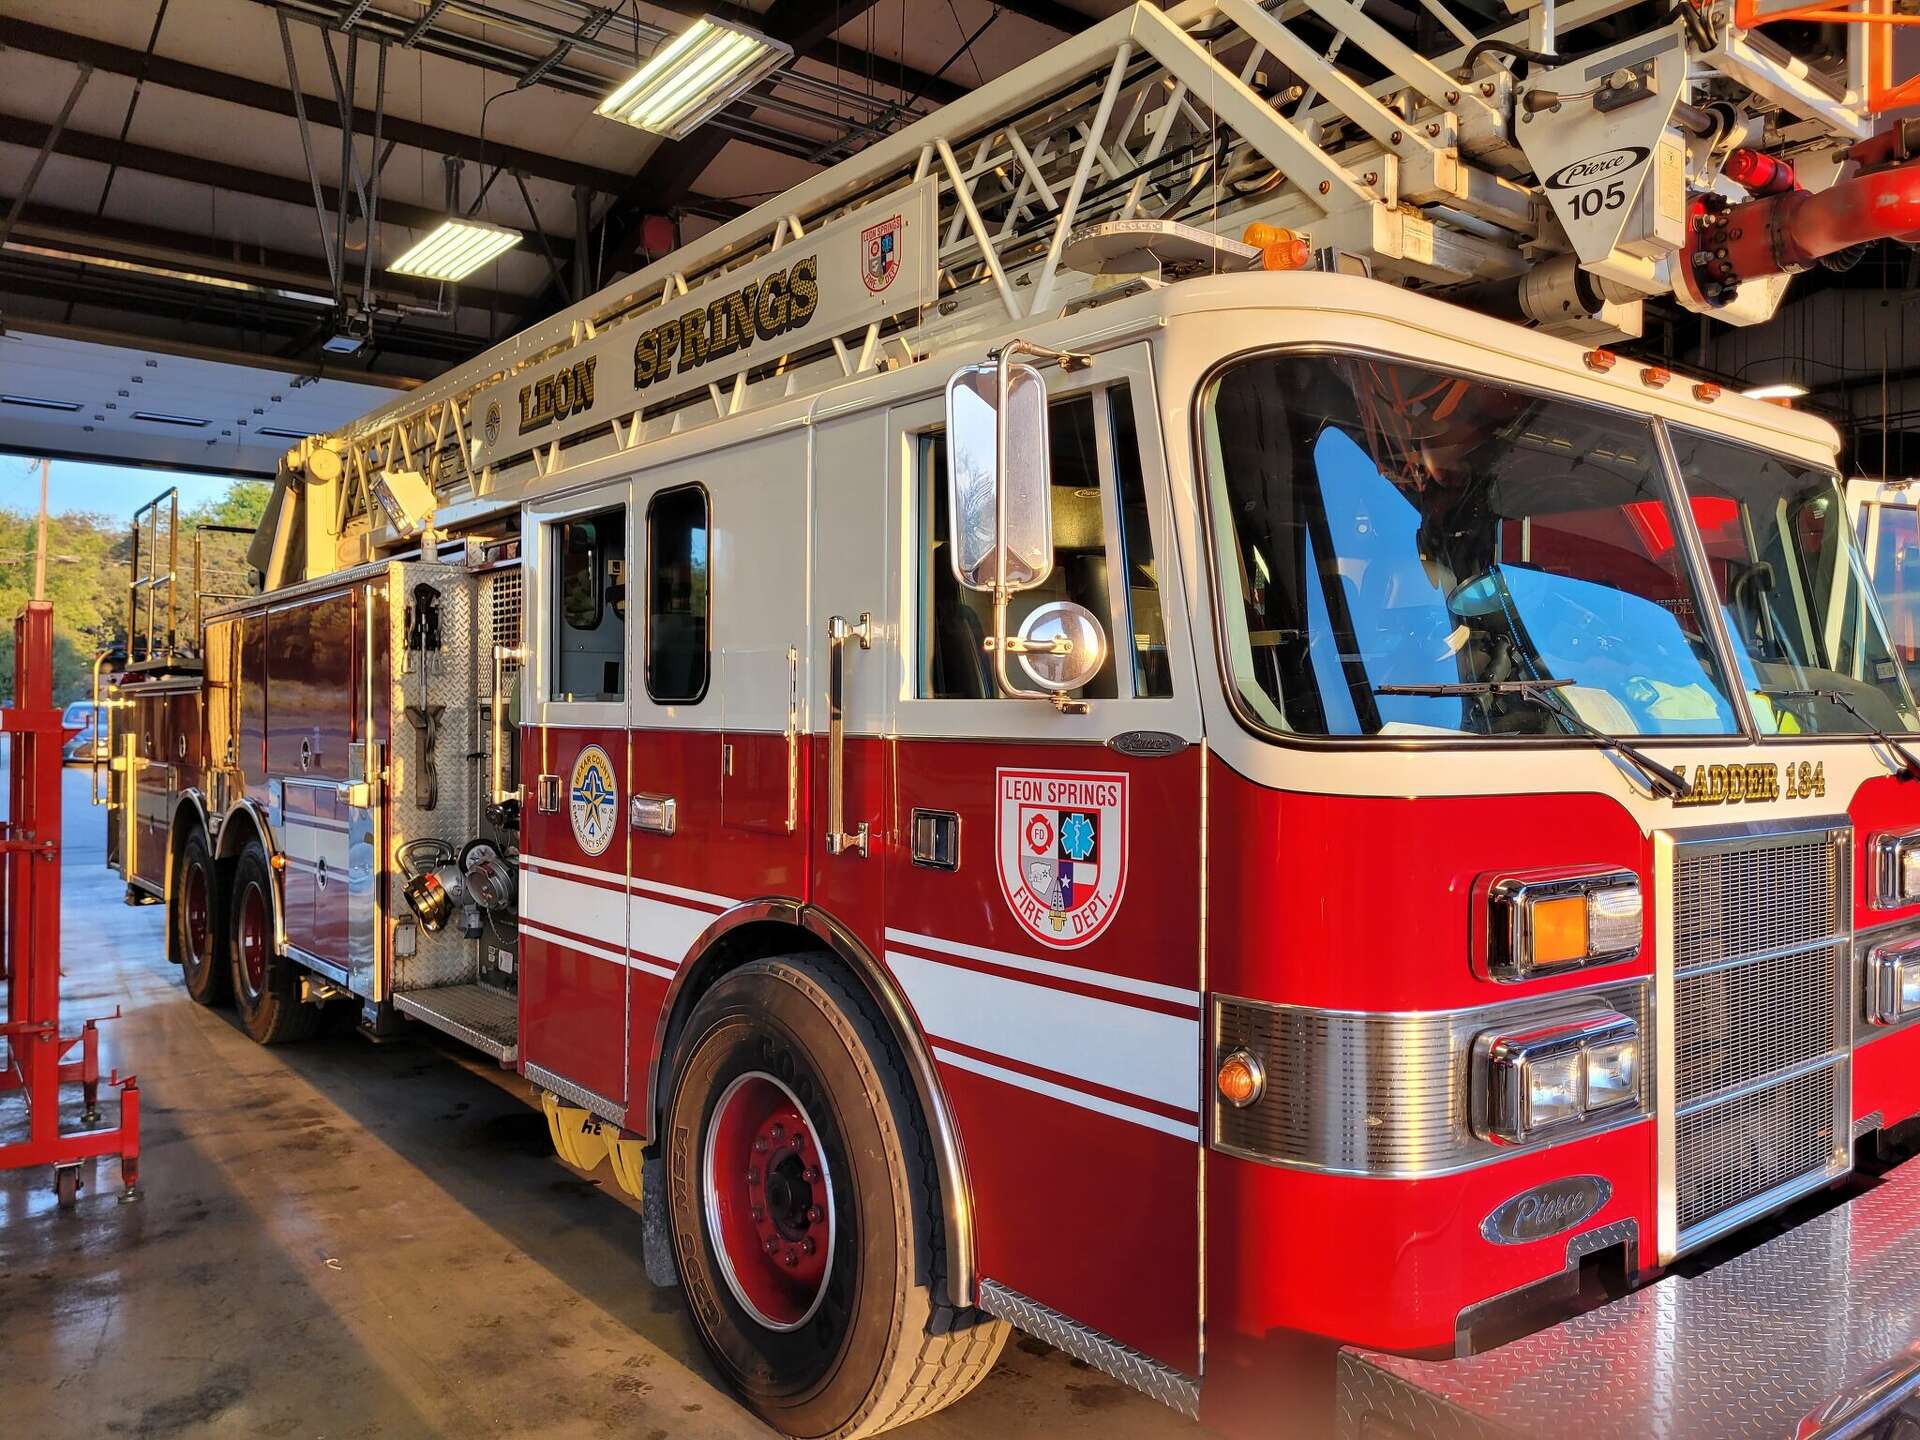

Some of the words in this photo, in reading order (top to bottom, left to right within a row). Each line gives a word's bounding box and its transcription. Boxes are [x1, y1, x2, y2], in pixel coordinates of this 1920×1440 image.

[1565, 155, 1624, 185] Pierce
[1568, 180, 1626, 221] 105
[518, 354, 597, 435] LEON
[633, 254, 819, 391] SPRINGS
[591, 754, 612, 788] COUNTY
[1672, 763, 1780, 808] LADDER
[1005, 779, 1042, 802] LEON
[1047, 781, 1118, 807] SPRINGS
[588, 822, 595, 837] 4
[1034, 828, 1045, 841] FD
[1013, 886, 1044, 928] FIRE
[674, 1126, 690, 1216] MSA
[1512, 1190, 1585, 1238] Pierce
